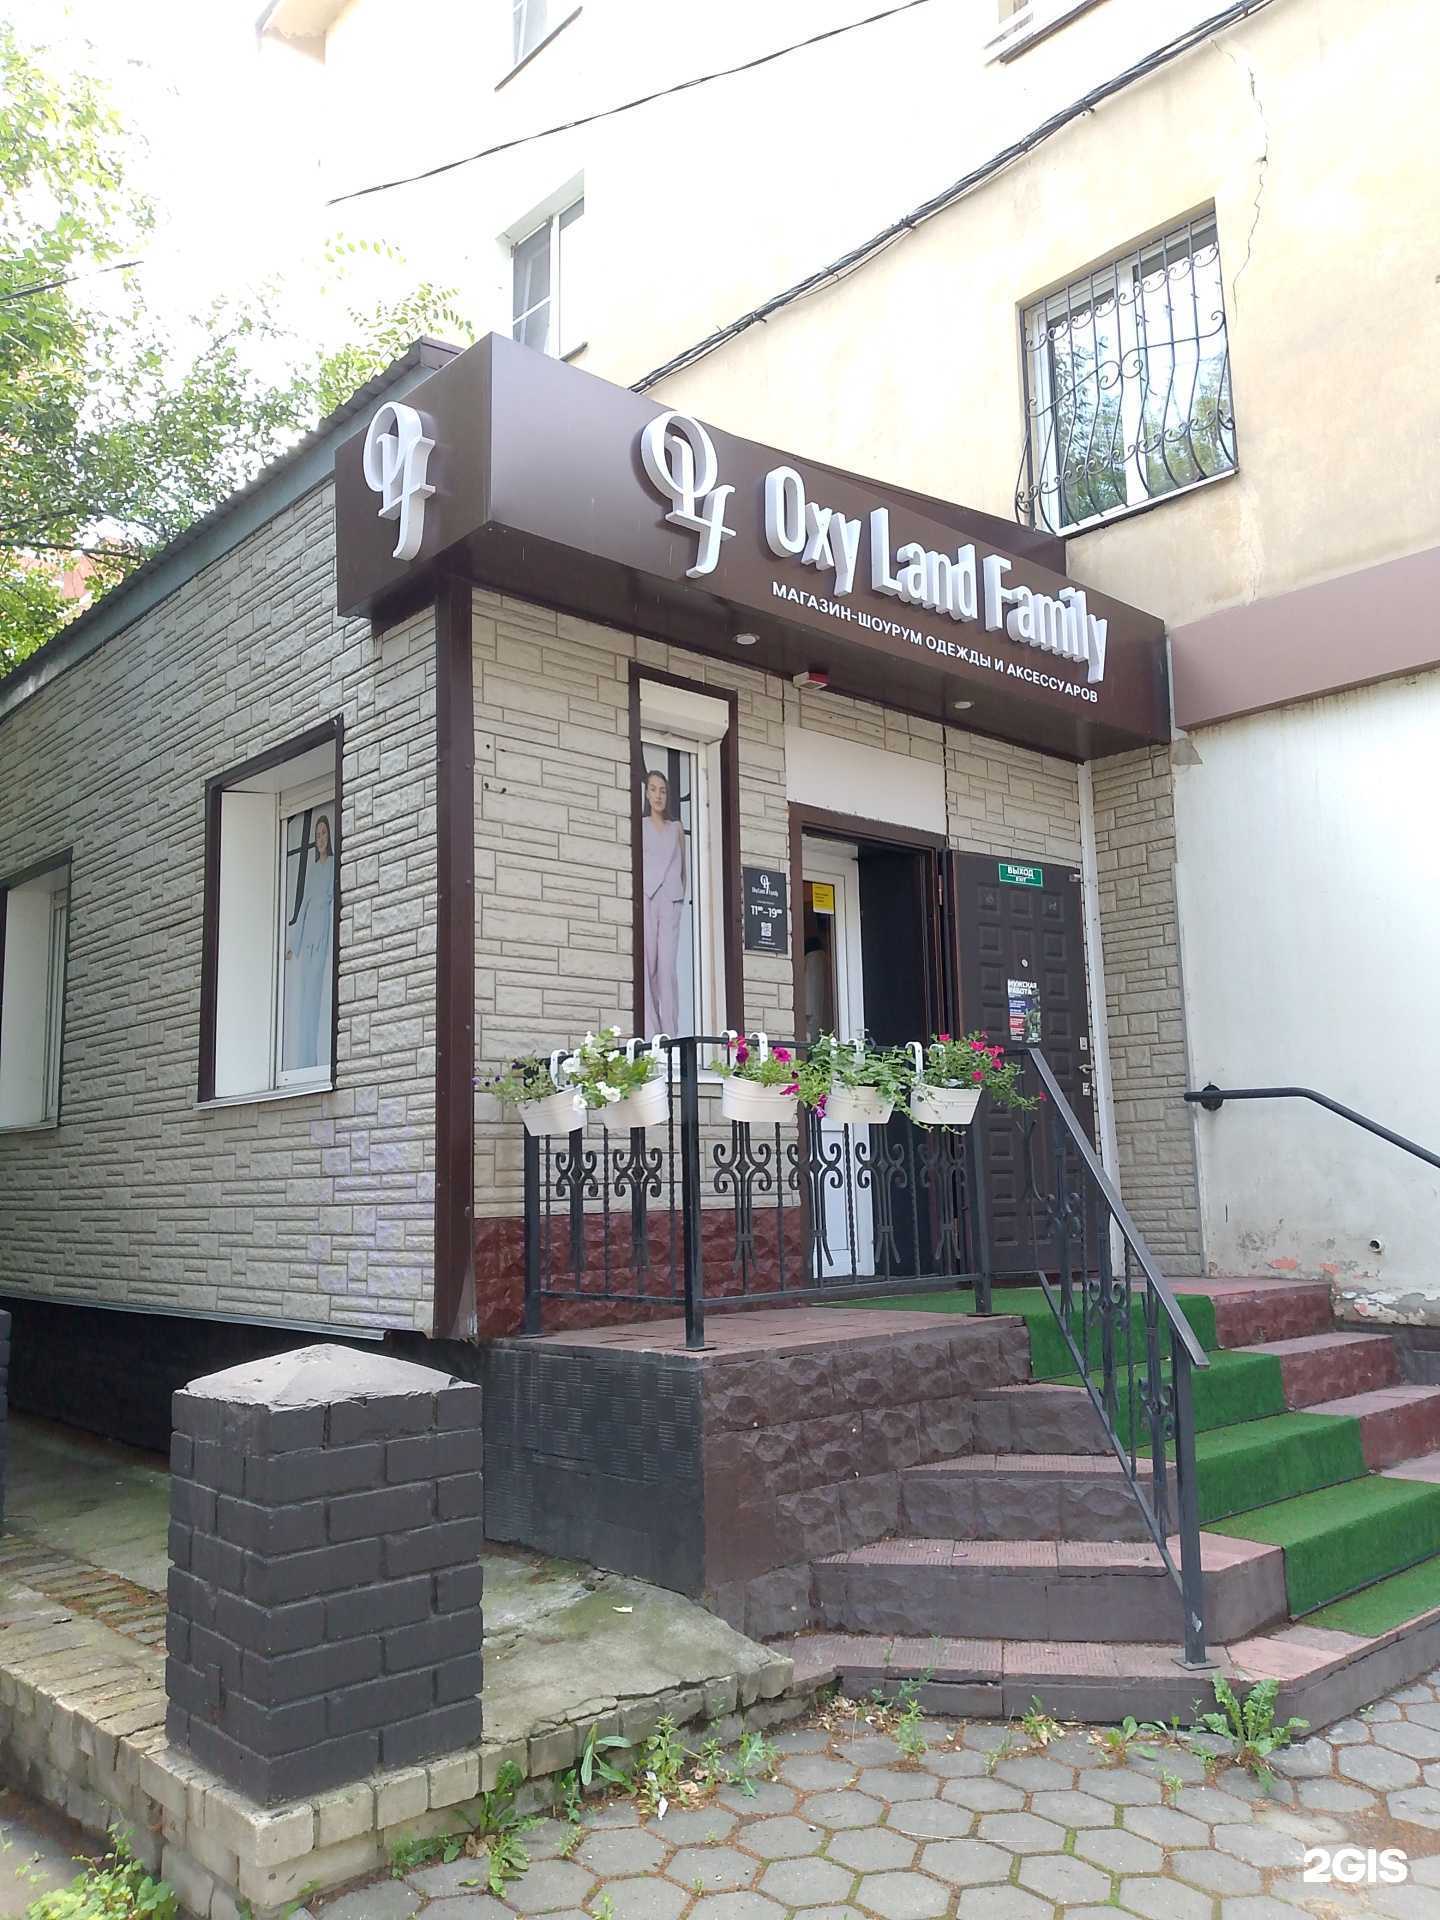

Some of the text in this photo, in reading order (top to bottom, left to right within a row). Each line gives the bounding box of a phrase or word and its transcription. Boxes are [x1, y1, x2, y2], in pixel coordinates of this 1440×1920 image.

[765, 465, 1108, 684] Oxy Land Family
[772, 581, 1098, 703] МАГАЗИН-ШОУРУМ ОДЕЖДЫ И АКСЕССУАРОВ
[1007, 865, 1034, 878] ВЫХОД
